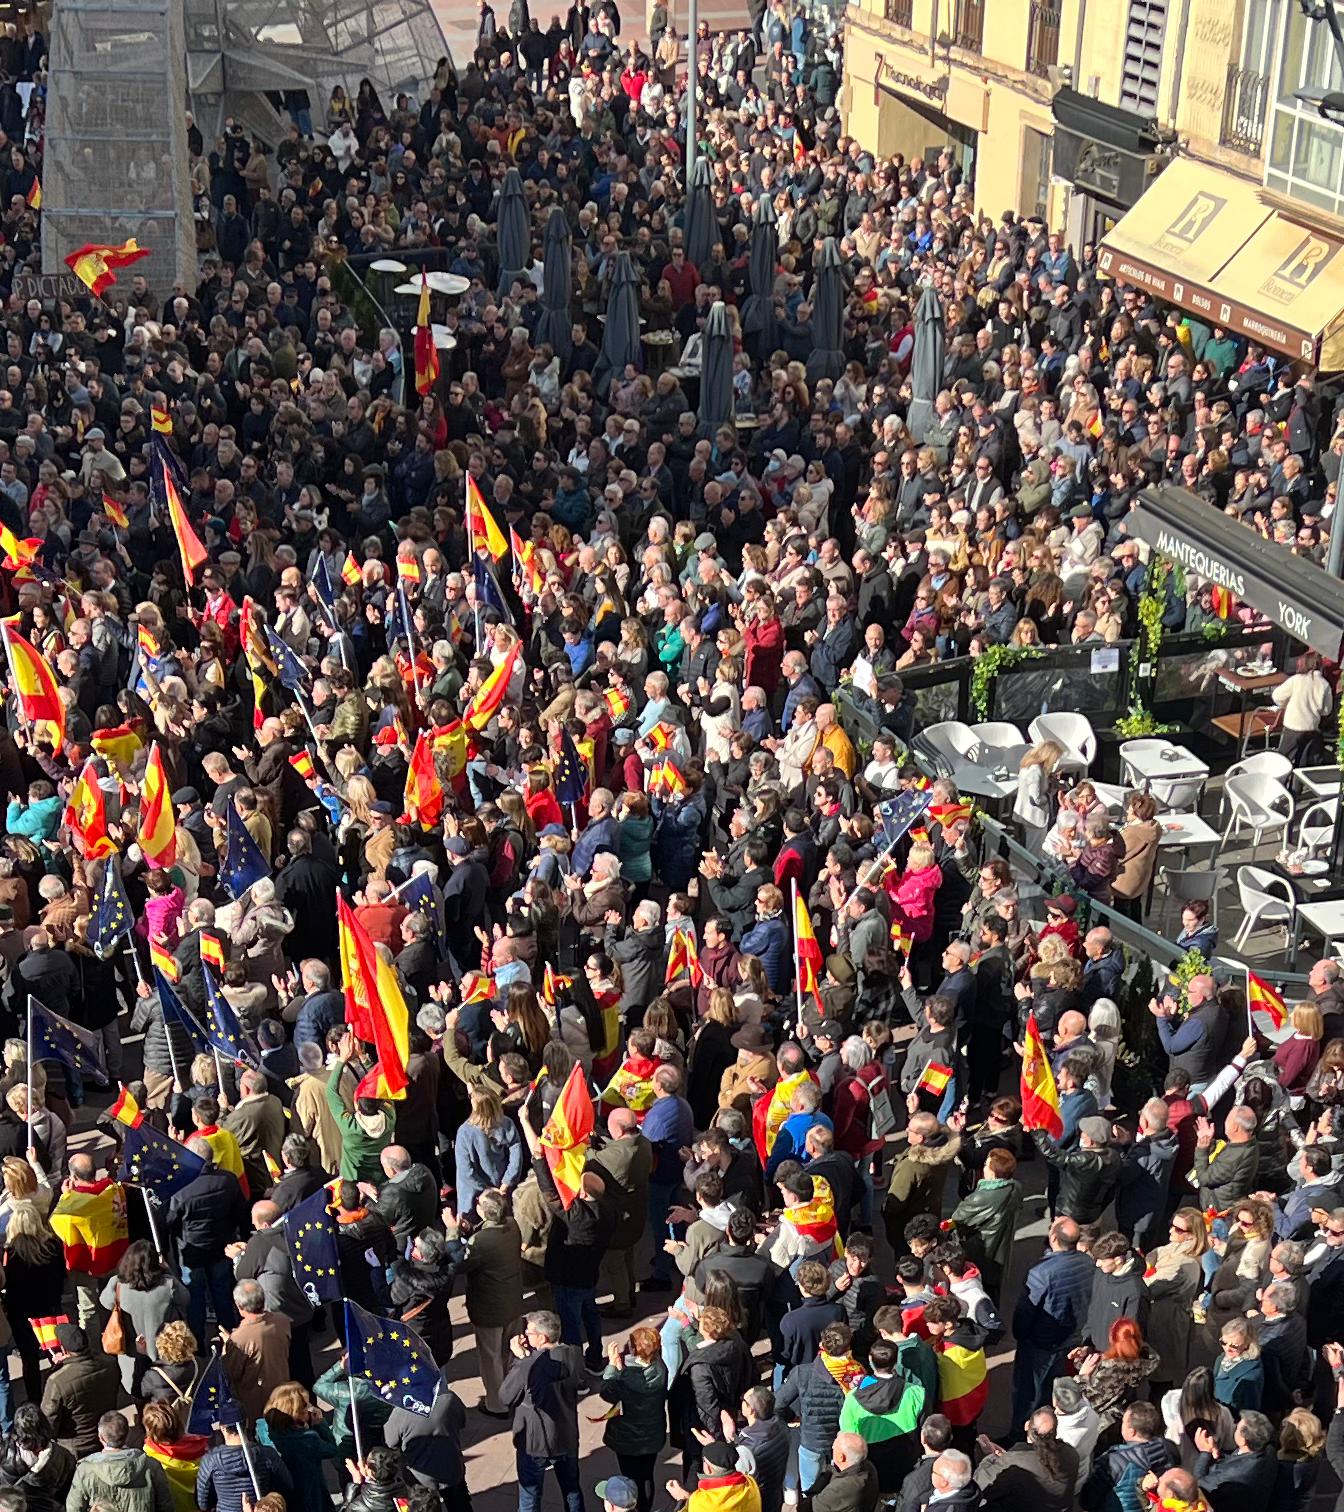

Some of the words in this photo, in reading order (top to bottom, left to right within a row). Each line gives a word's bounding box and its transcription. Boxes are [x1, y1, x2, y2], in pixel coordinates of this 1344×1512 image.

[1168, 194, 1216, 240] R
[1277, 235, 1330, 287] R
[27, 275, 87, 298] DICTADO
[1156, 530, 1246, 597] MANTEQUERIAS
[1278, 602, 1312, 640] YORK
